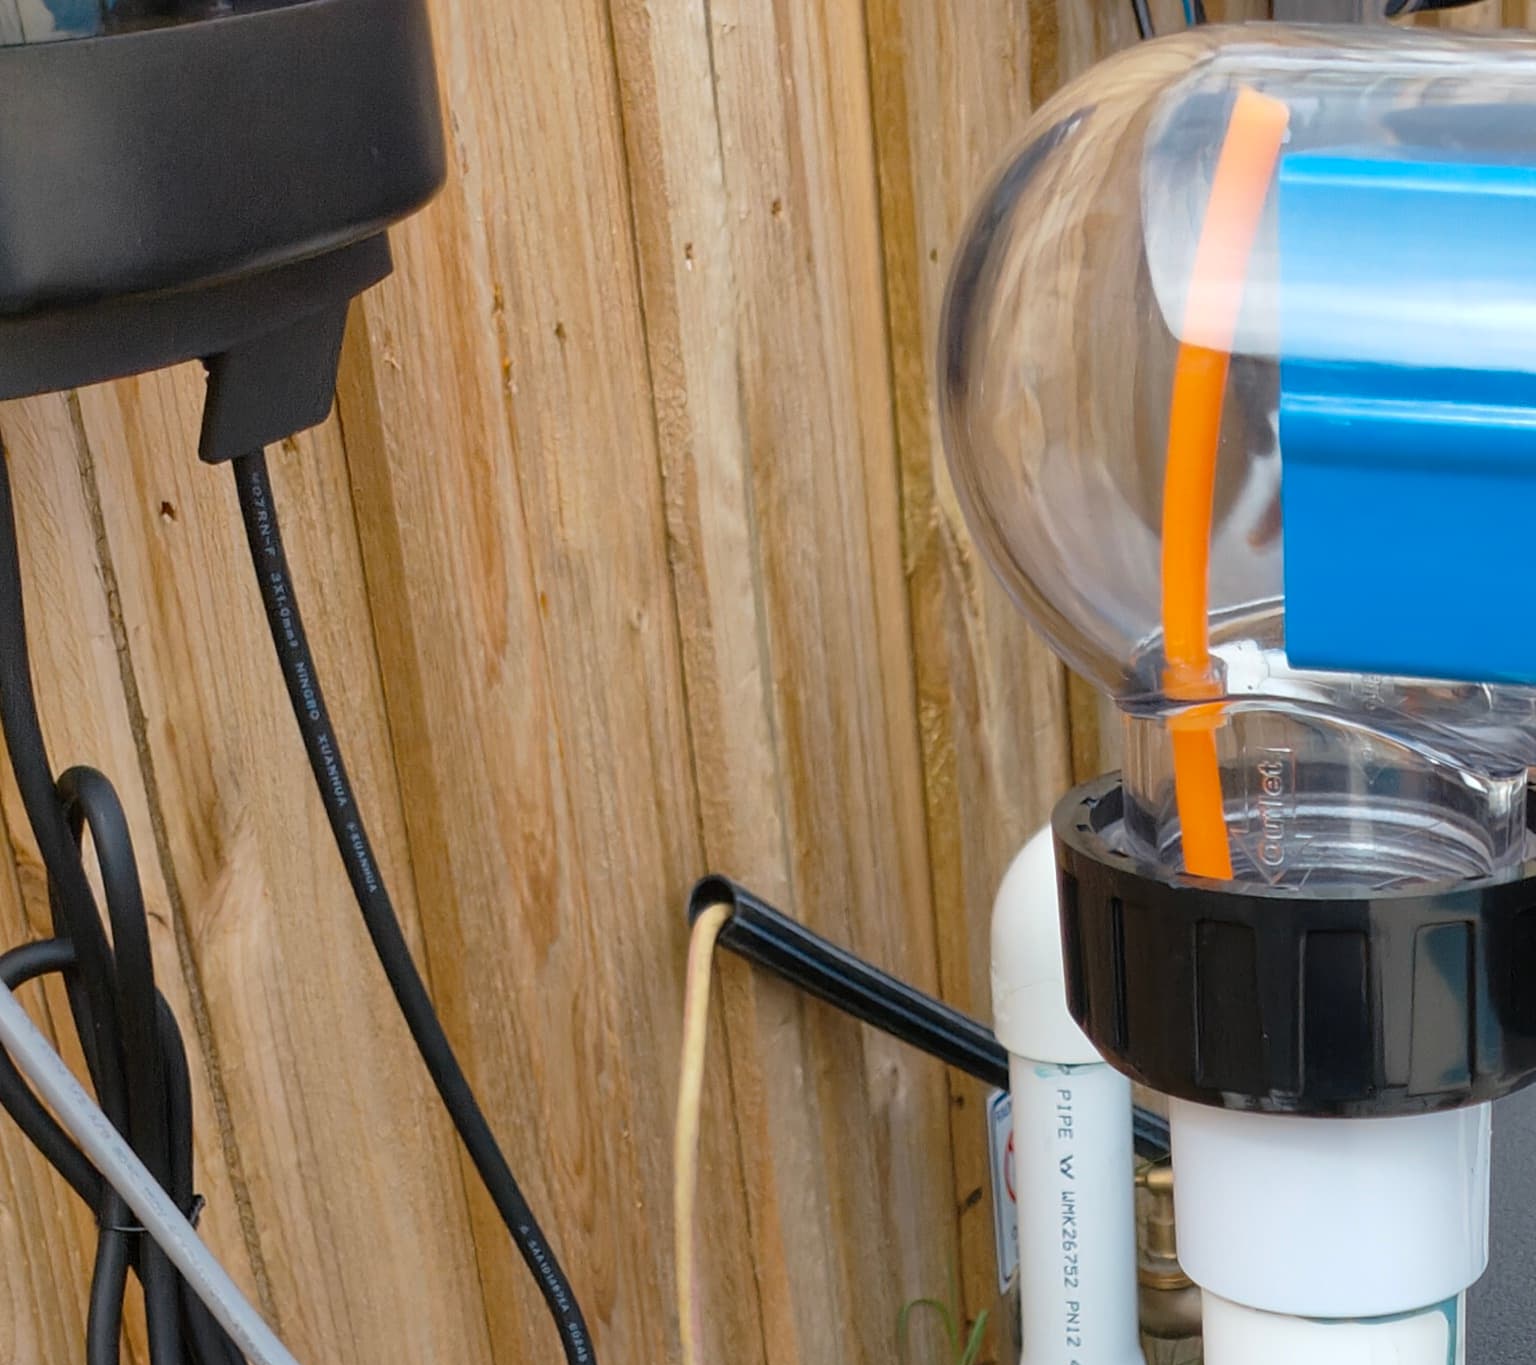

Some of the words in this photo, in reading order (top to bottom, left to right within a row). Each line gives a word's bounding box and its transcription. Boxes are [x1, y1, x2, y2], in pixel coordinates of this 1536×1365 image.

[294, 661, 320, 721] NINGBO
[316, 733, 347, 807] XUANHUA
[1258, 760, 1284, 866] Outlet
[1057, 1089, 1072, 1140] PIPE
[1061, 1191, 1079, 1289] WMK26752
[1066, 1301, 1081, 1348] PN12
